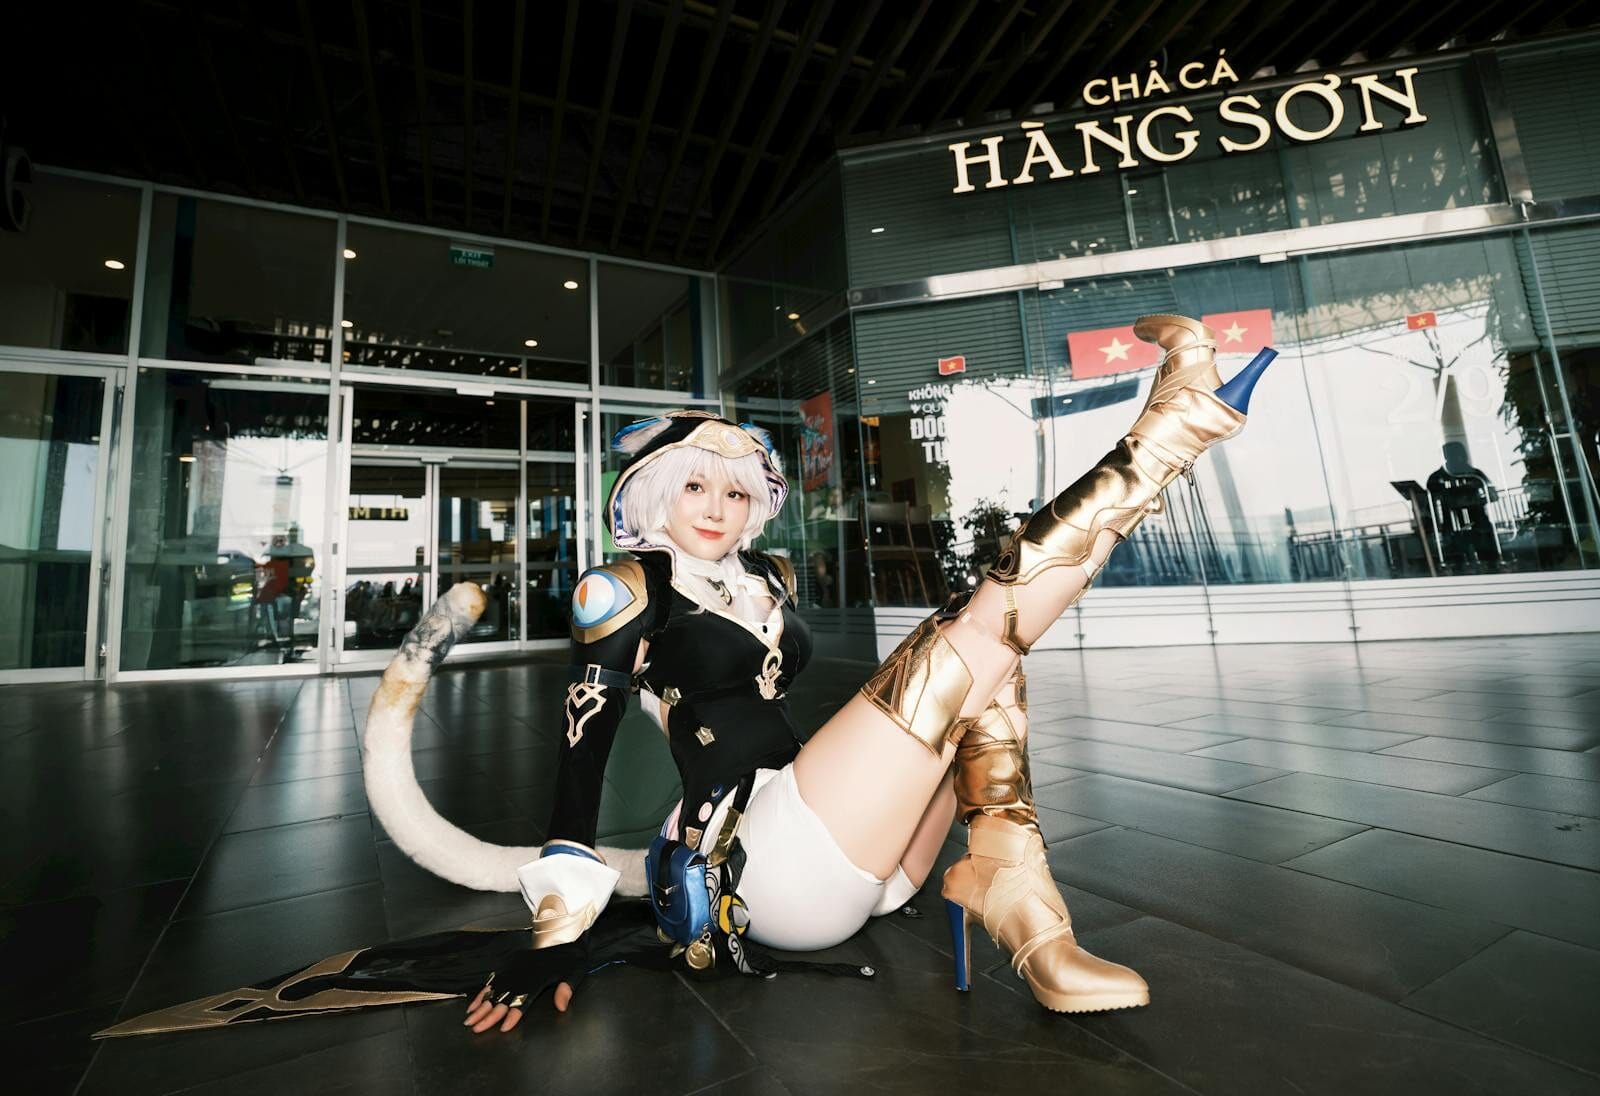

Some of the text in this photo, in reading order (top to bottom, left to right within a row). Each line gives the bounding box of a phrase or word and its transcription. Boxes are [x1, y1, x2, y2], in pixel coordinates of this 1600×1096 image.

[1082, 48, 1240, 106] CHẢ CÁ
[948, 67, 1428, 194] HÀNG SƠN
[908, 383, 951, 400] KHÔNG
